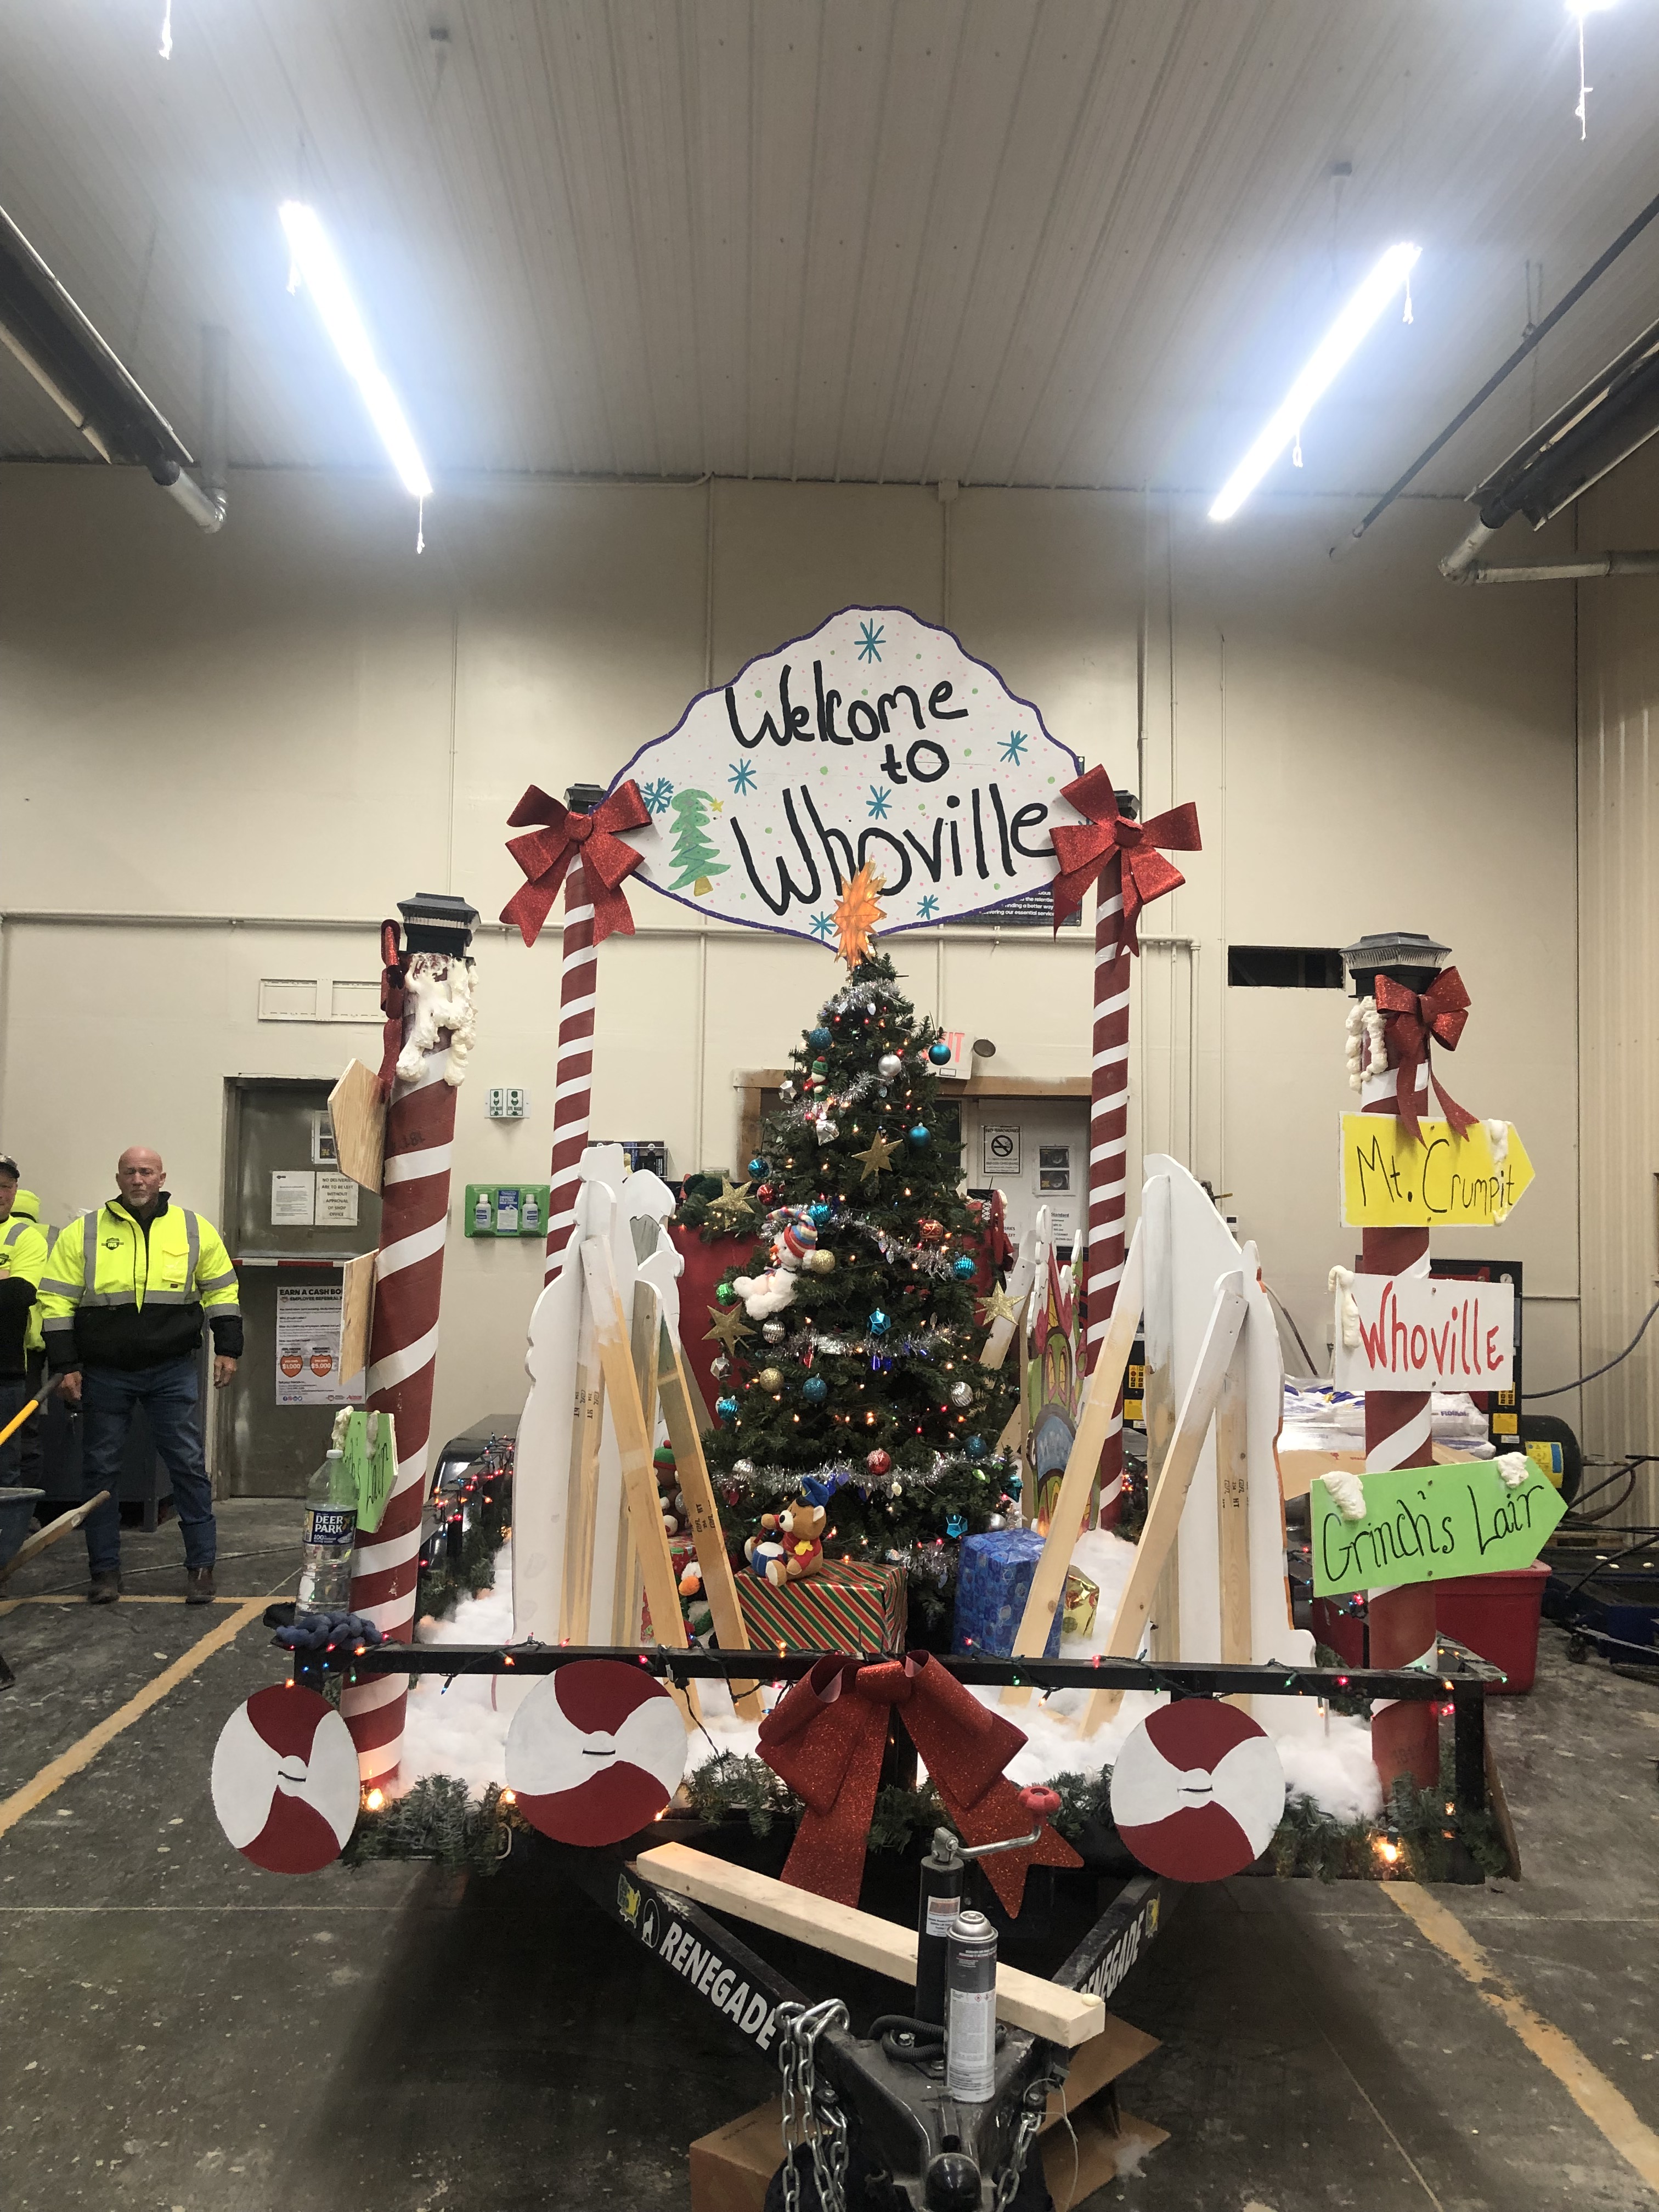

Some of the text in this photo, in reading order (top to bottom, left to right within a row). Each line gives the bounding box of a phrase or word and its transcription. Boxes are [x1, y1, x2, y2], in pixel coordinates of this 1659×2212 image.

[726, 660, 968, 748] Welcome
[880, 739, 950, 785] to
[731, 784, 1056, 916] Whoville
[1357, 1136, 1514, 1215] Mt. Crumpit
[1352, 1280, 1504, 1376] Whoville
[314, 1524, 343, 1534] PARK
[315, 1515, 343, 1525] DEER
[1323, 1483, 1544, 1582] Grinch's Lair
[659, 1921, 777, 2051] RENEGADE
[1080, 1908, 1146, 2000] ENEGADE
